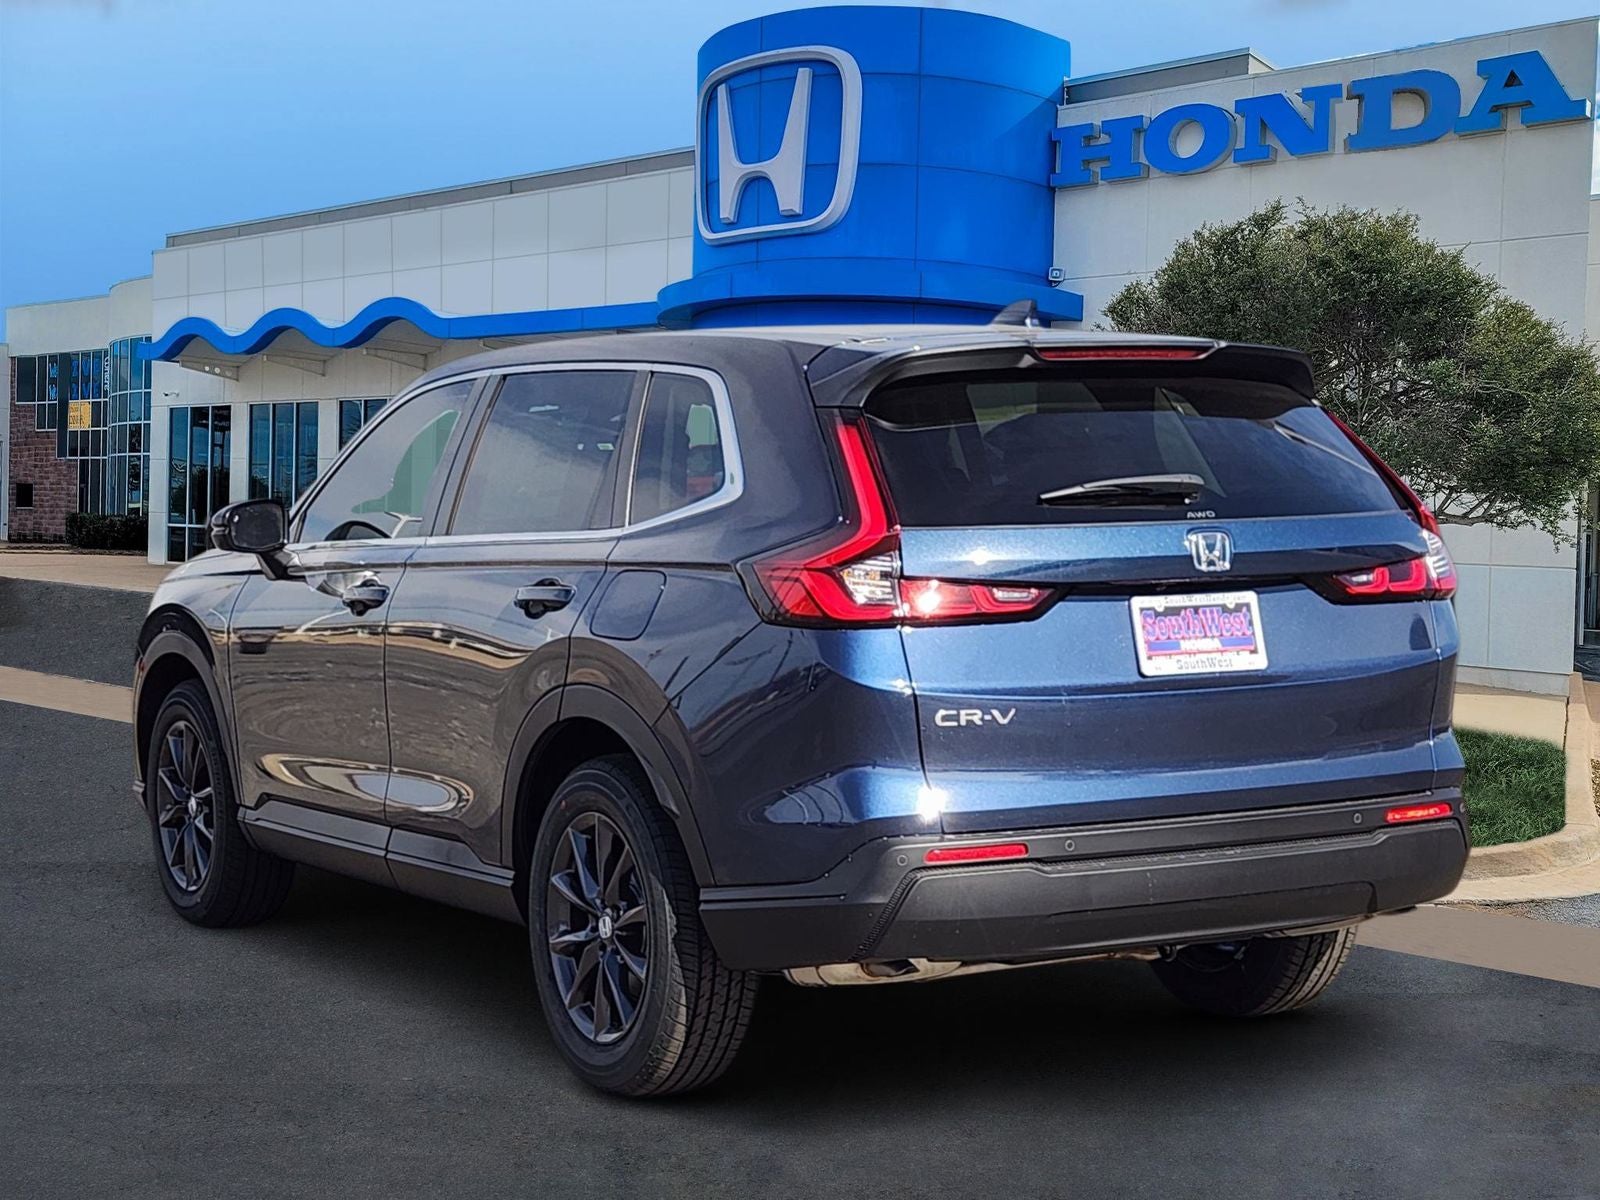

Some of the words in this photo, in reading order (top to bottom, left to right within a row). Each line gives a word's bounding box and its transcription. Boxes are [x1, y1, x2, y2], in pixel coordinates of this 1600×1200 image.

[1050, 50, 1591, 187] HONDA
[1187, 510, 1216, 519] AWD
[1141, 606, 1252, 641] SouthWest
[1176, 656, 1233, 670] SouthWest
[934, 707, 1017, 727] CR-V
